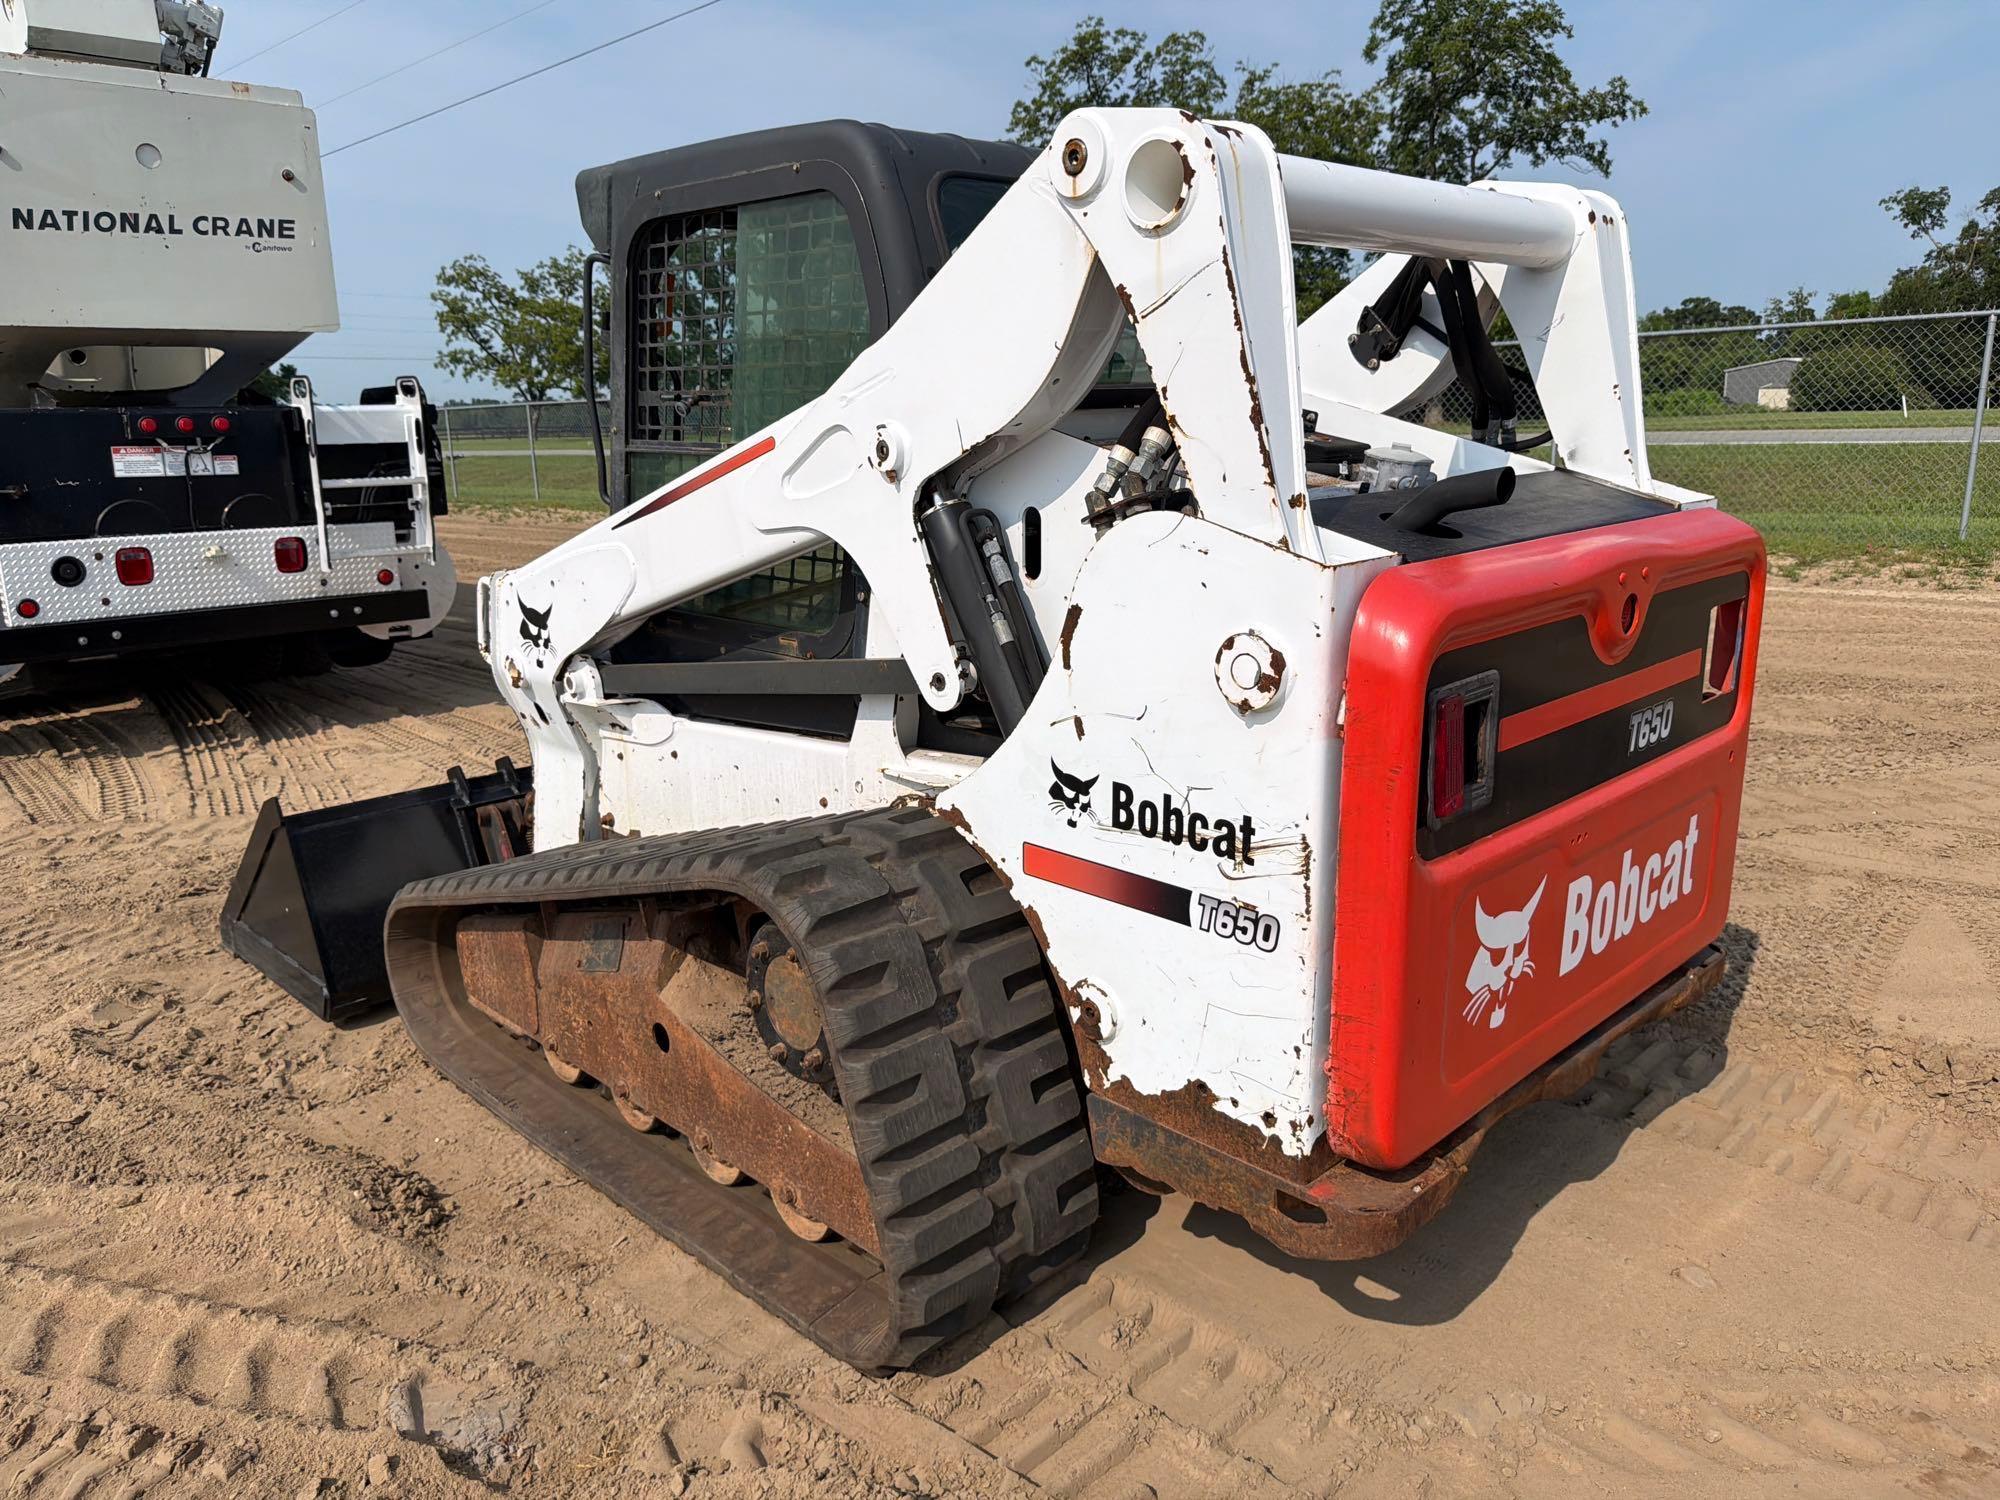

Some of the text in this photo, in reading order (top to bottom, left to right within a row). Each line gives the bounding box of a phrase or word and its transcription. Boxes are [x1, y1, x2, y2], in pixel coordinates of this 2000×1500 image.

[12, 207, 296, 240] NATIONAL CRANE
[1629, 697, 1675, 754] T650
[1112, 780, 1256, 867] Bobcat
[1197, 893, 1281, 953] T650
[1559, 813, 1699, 978] Bobcat
